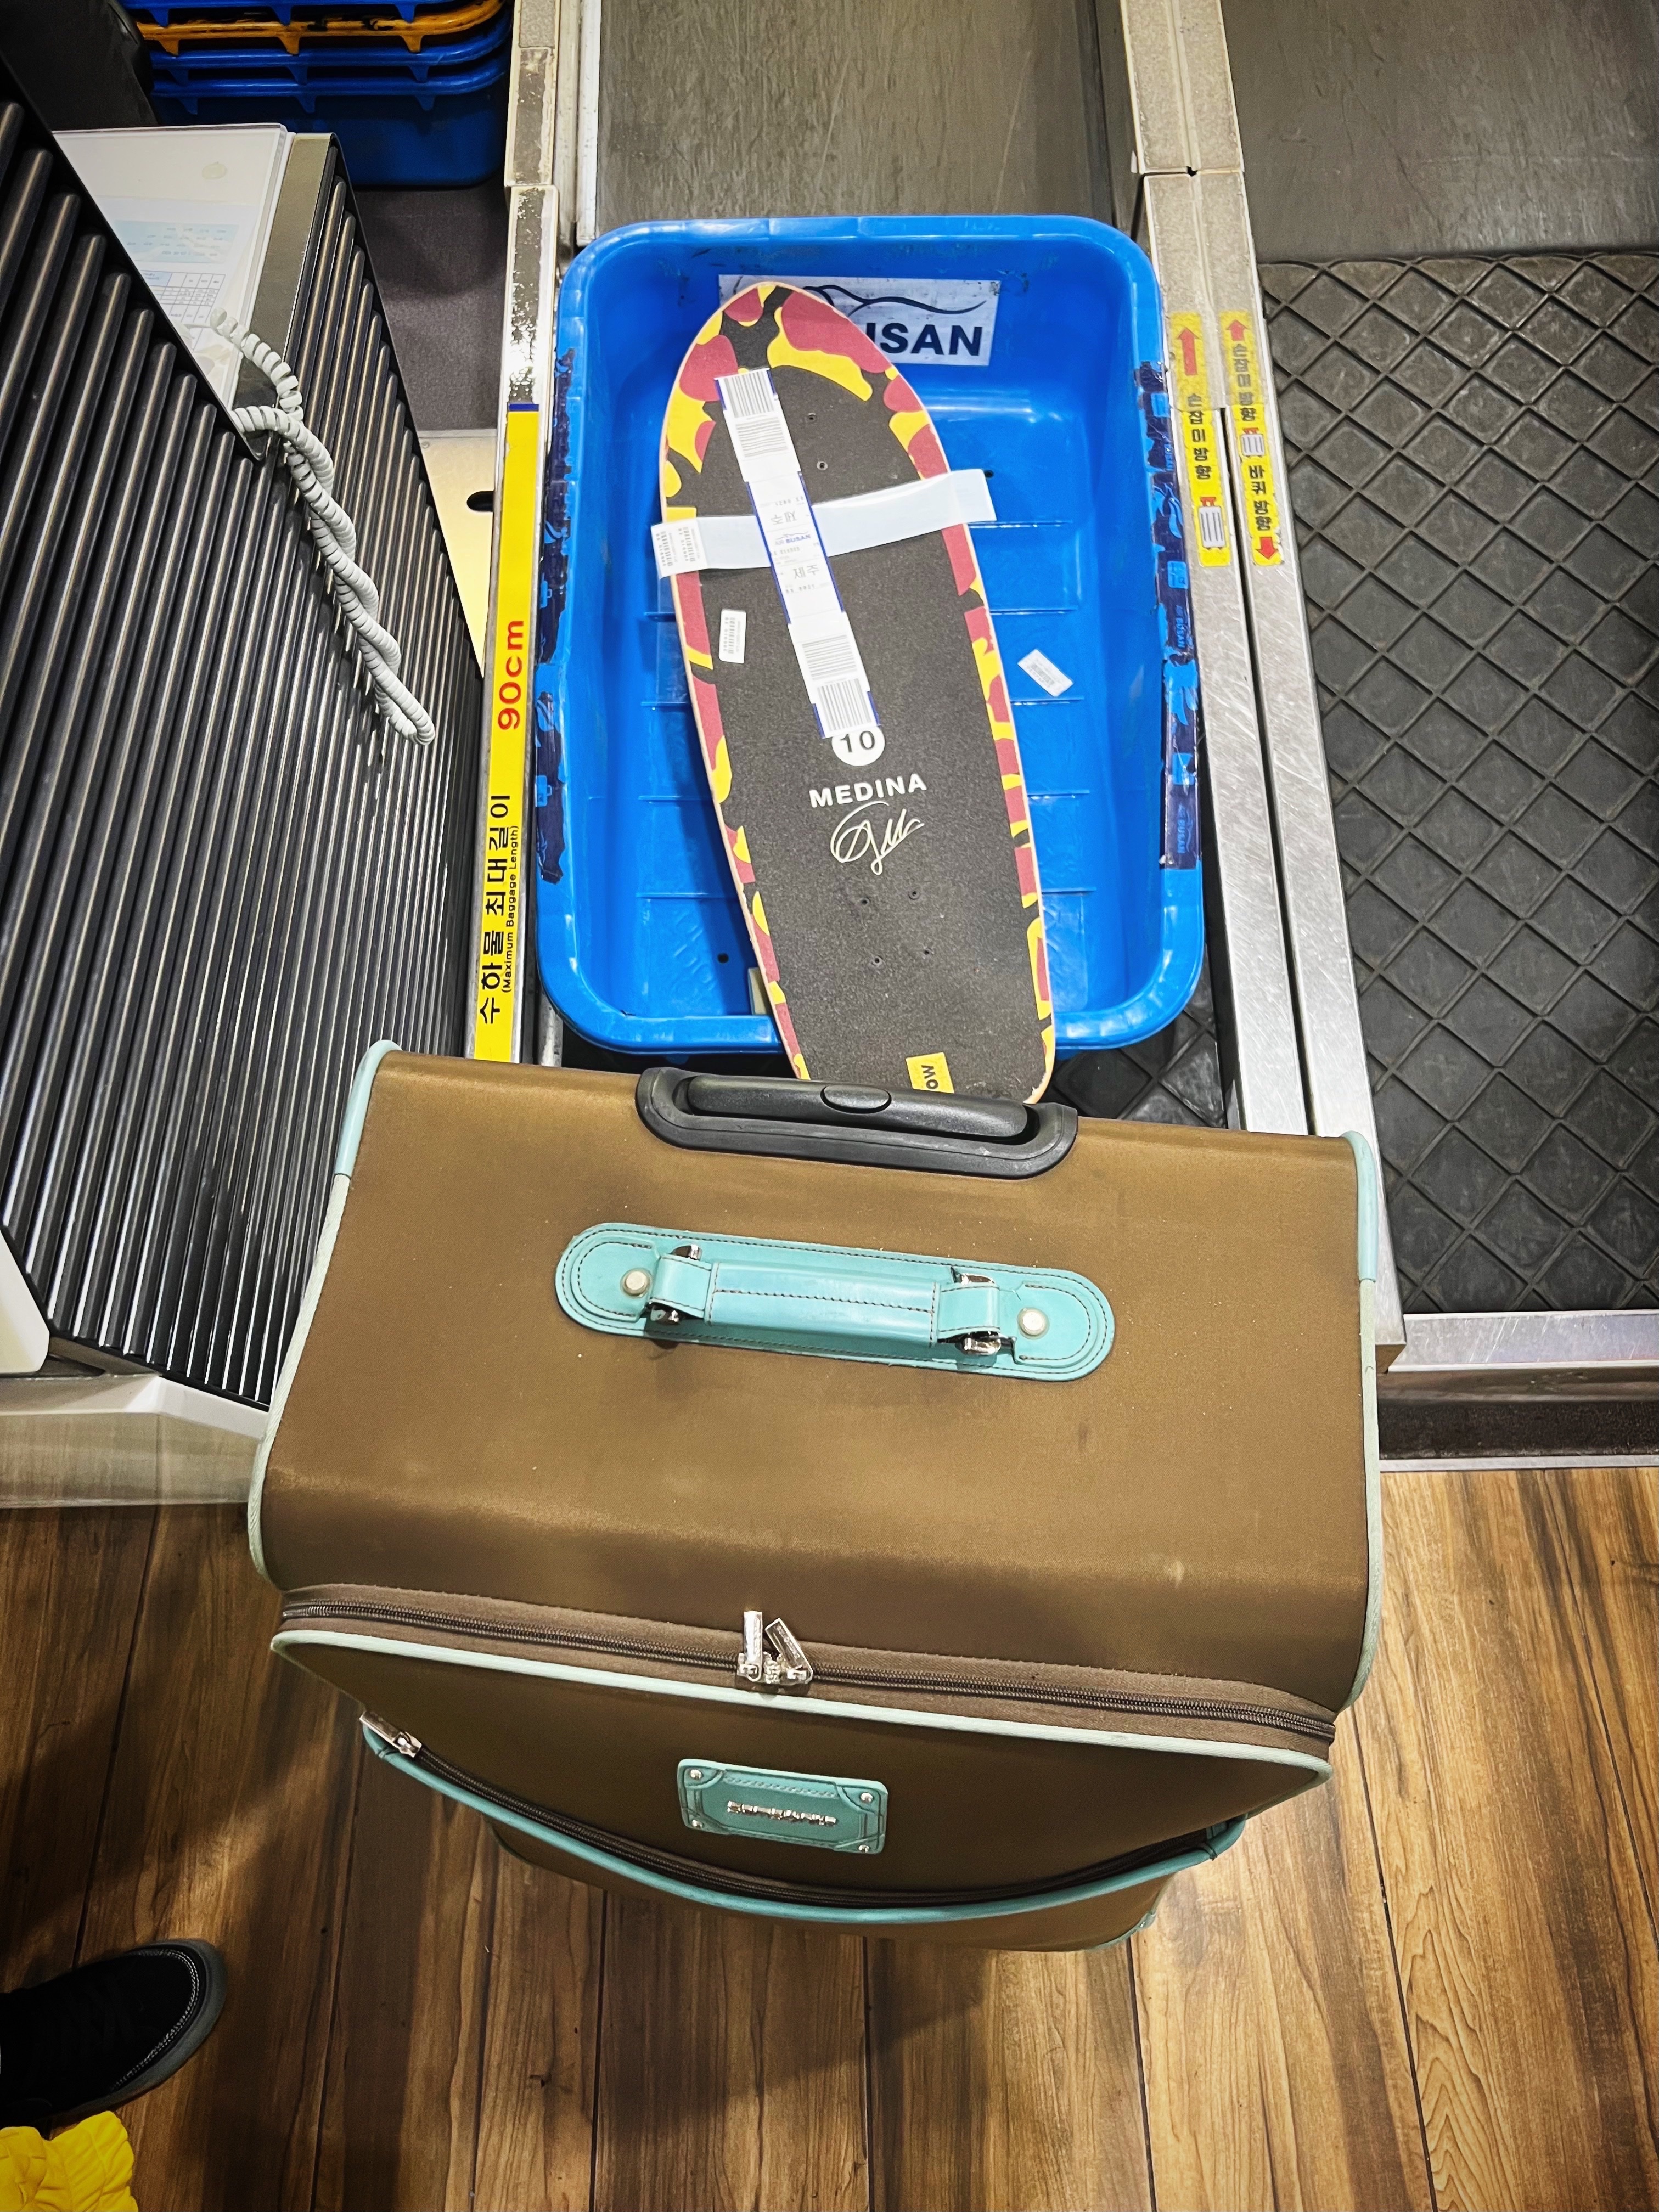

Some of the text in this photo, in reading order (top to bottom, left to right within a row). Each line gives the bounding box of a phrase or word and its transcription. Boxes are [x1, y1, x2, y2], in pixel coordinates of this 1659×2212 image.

[866, 322, 982, 356] SAN
[1193, 447, 1211, 480] 방향
[1249, 465, 1272, 531] 바퀴 방향
[786, 534, 811, 544] BUSAN
[793, 564, 819, 579] 제주
[498, 621, 524, 730] 90cm
[840, 730, 875, 753] 10
[809, 773, 927, 808] MEDINA
[480, 795, 510, 1025] 수하물 최대길이
[502, 825, 520, 993] (Maximum Baggage Length)
